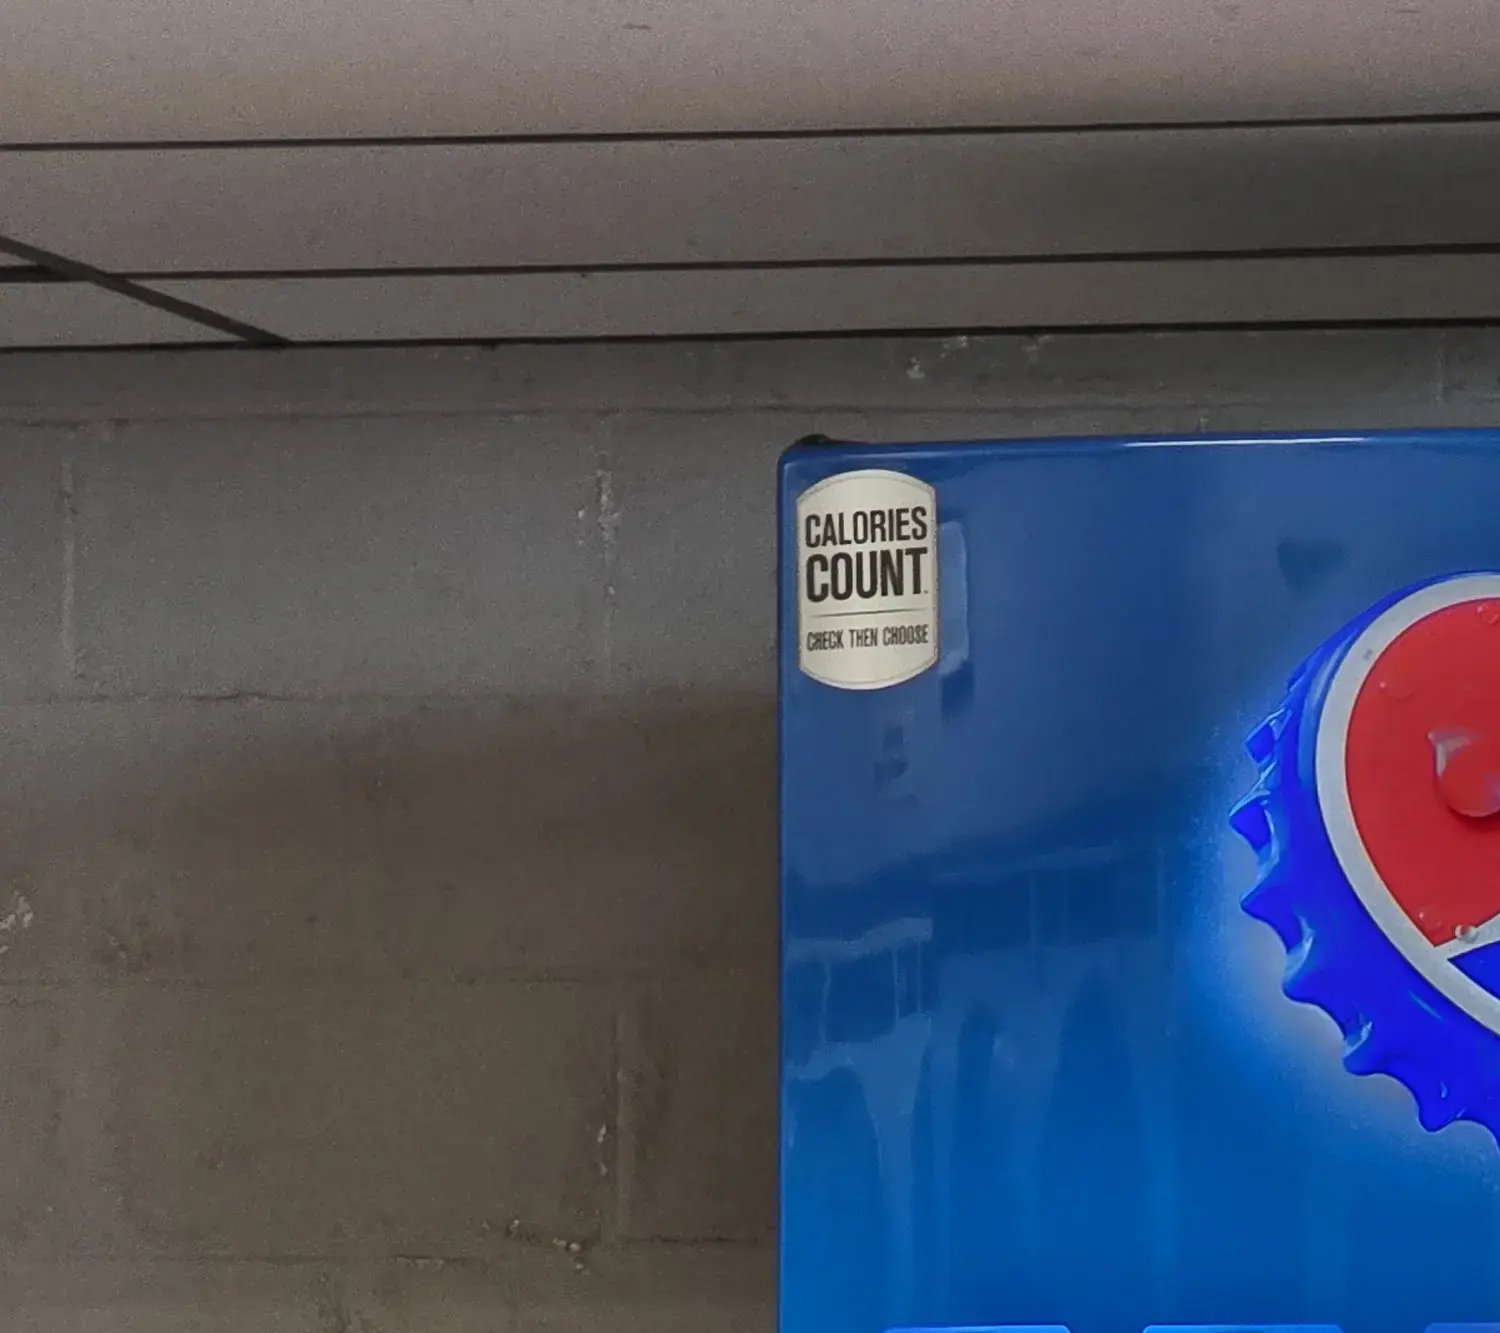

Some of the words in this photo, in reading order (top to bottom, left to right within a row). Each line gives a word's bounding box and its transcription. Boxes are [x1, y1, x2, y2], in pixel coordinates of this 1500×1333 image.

[805, 506, 928, 548] CALORIES
[806, 547, 928, 603] COUNT
[807, 628, 844, 652] CHECK
[848, 627, 878, 649] THEN
[882, 624, 928, 647] CHOOSE
